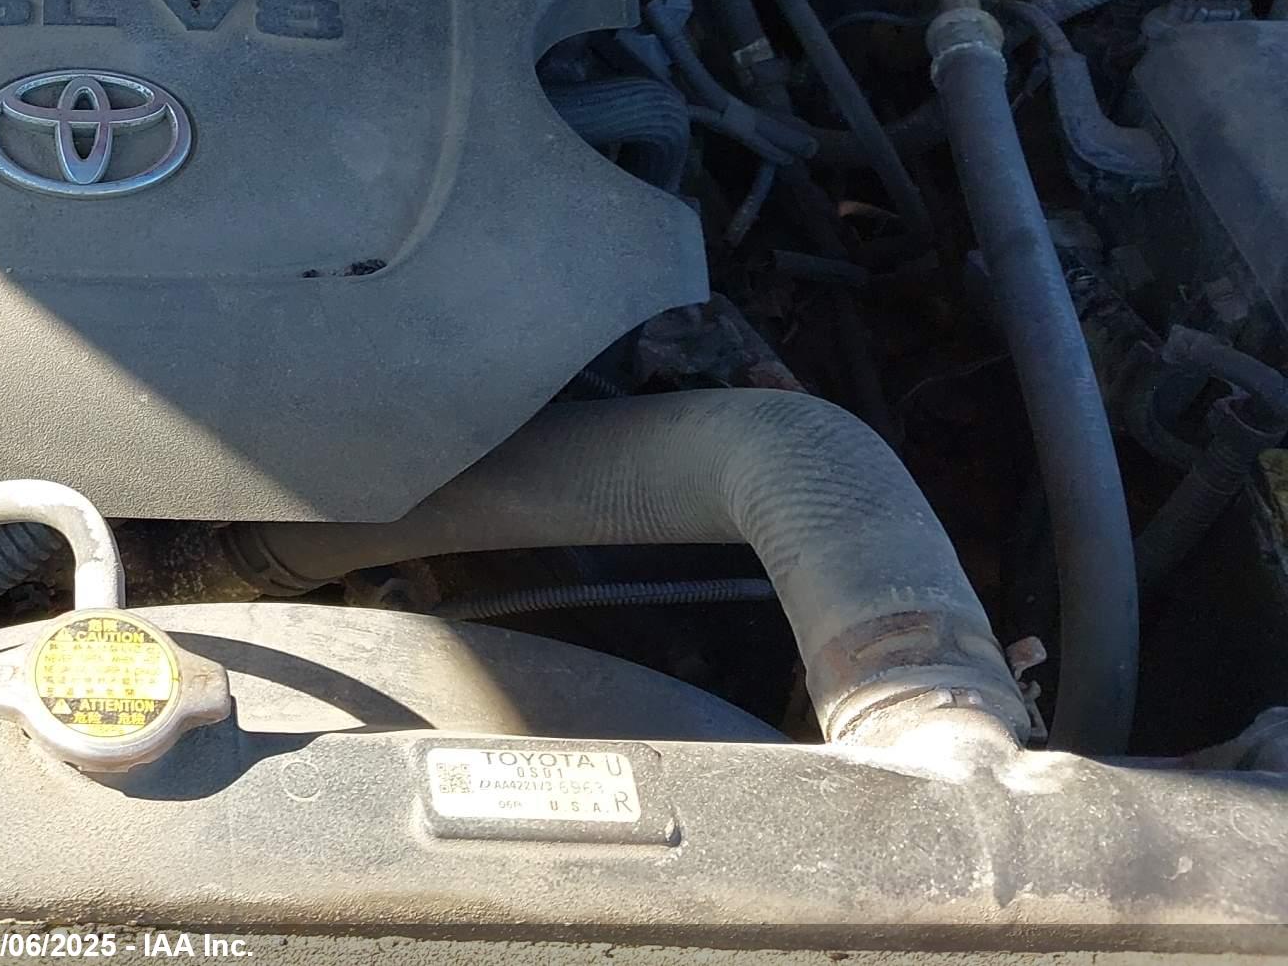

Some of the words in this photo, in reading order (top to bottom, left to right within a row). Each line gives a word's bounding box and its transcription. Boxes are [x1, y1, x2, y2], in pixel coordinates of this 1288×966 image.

[76, 631, 144, 644] CAUTION
[79, 698, 155, 713] ATTENTION
[481, 751, 595, 769] TOYOTA
[605, 756, 623, 777] U
[613, 791, 633, 814] R
